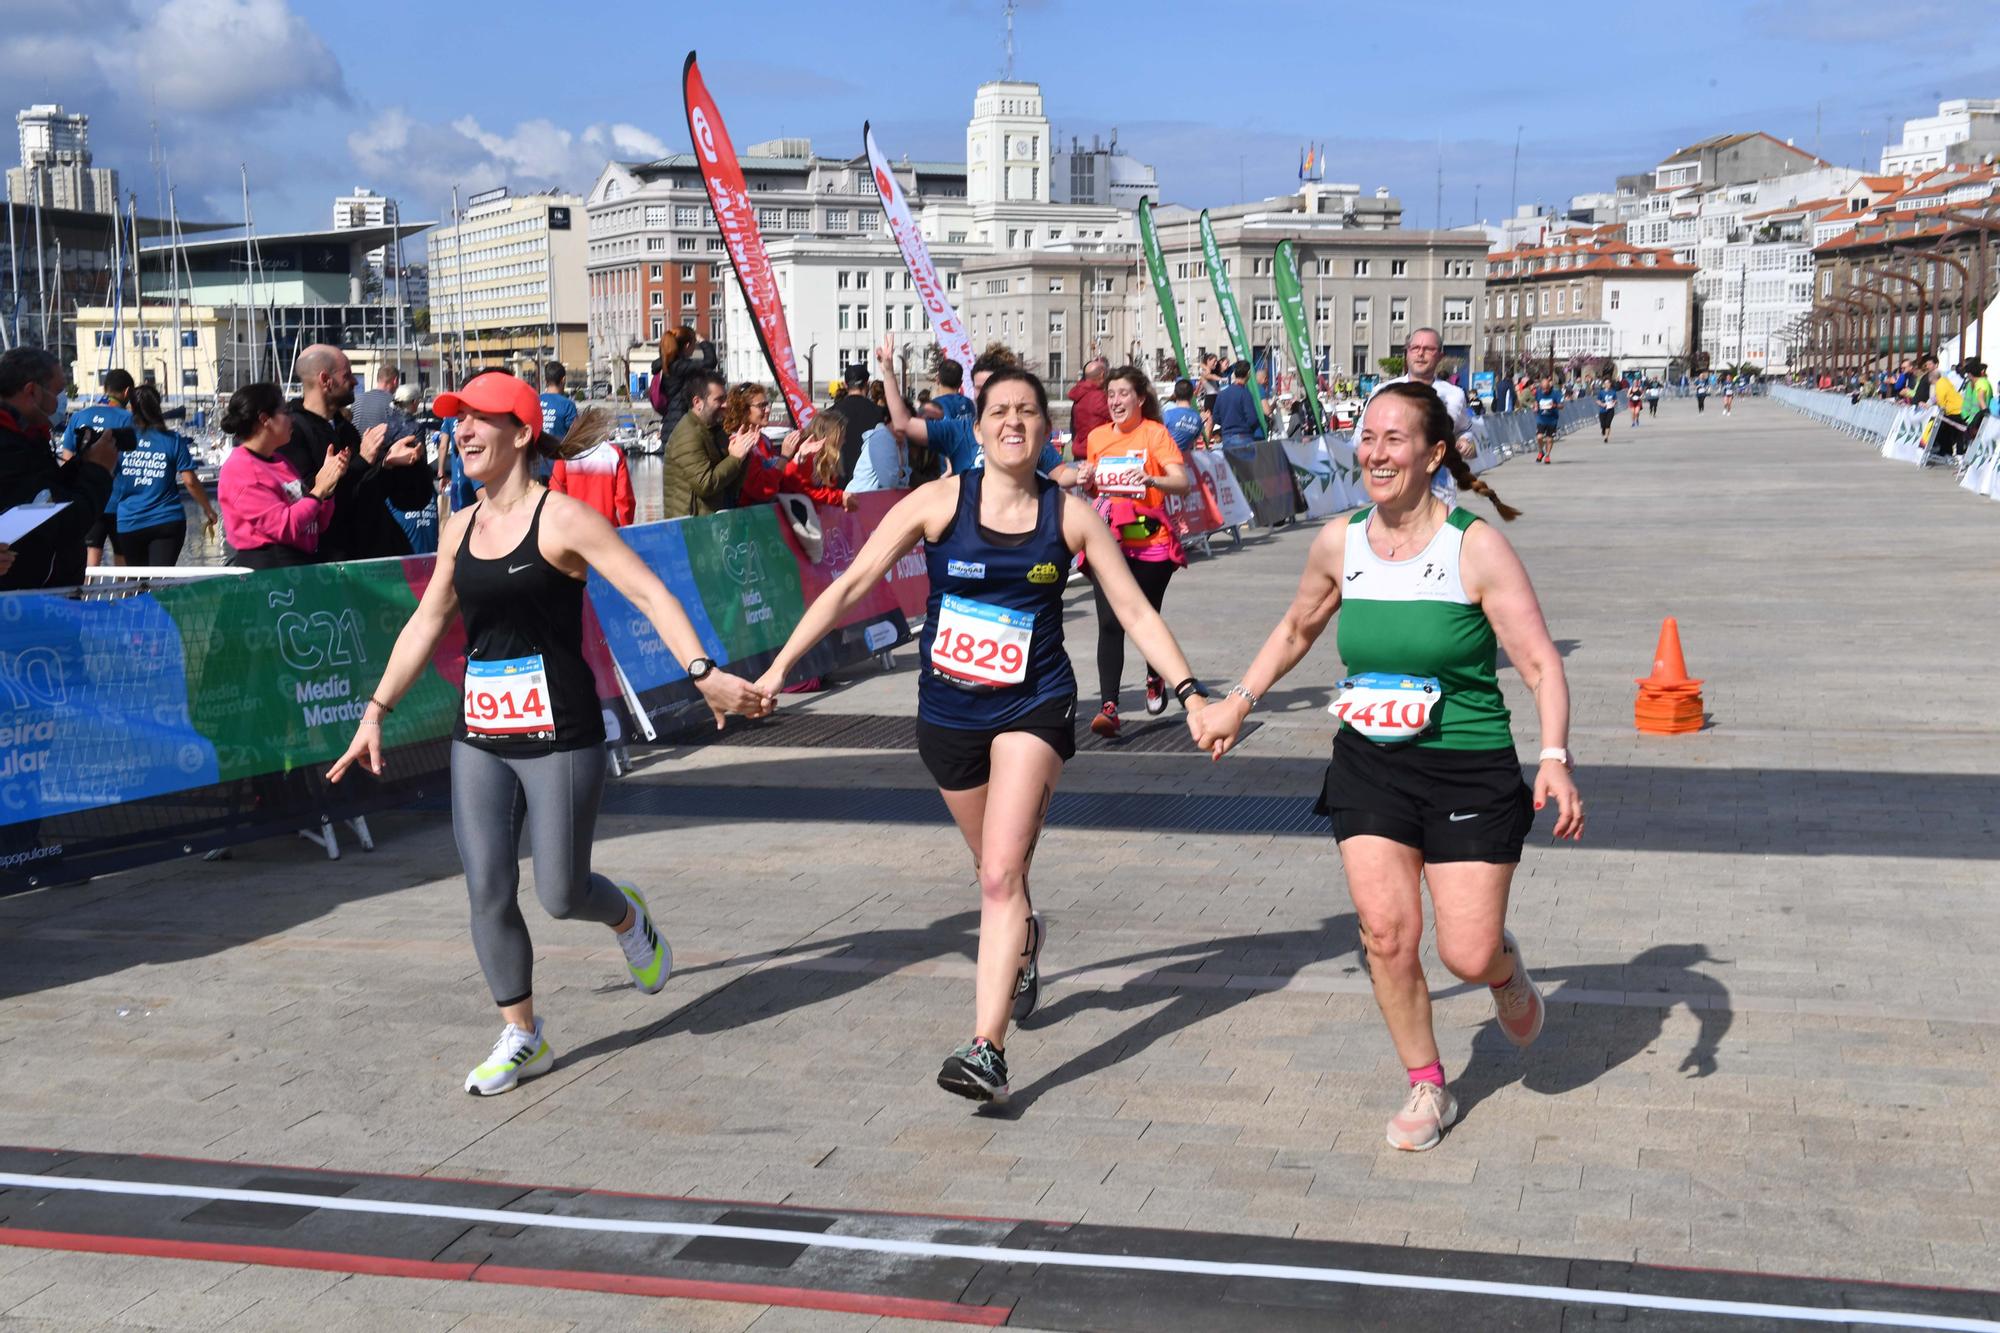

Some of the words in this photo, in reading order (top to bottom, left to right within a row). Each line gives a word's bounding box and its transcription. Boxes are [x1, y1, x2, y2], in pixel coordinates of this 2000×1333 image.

[122, 468, 141, 476] aos
[934, 627, 1023, 674] 1829
[296, 674, 350, 704] Media
[466, 688, 545, 720] 1914
